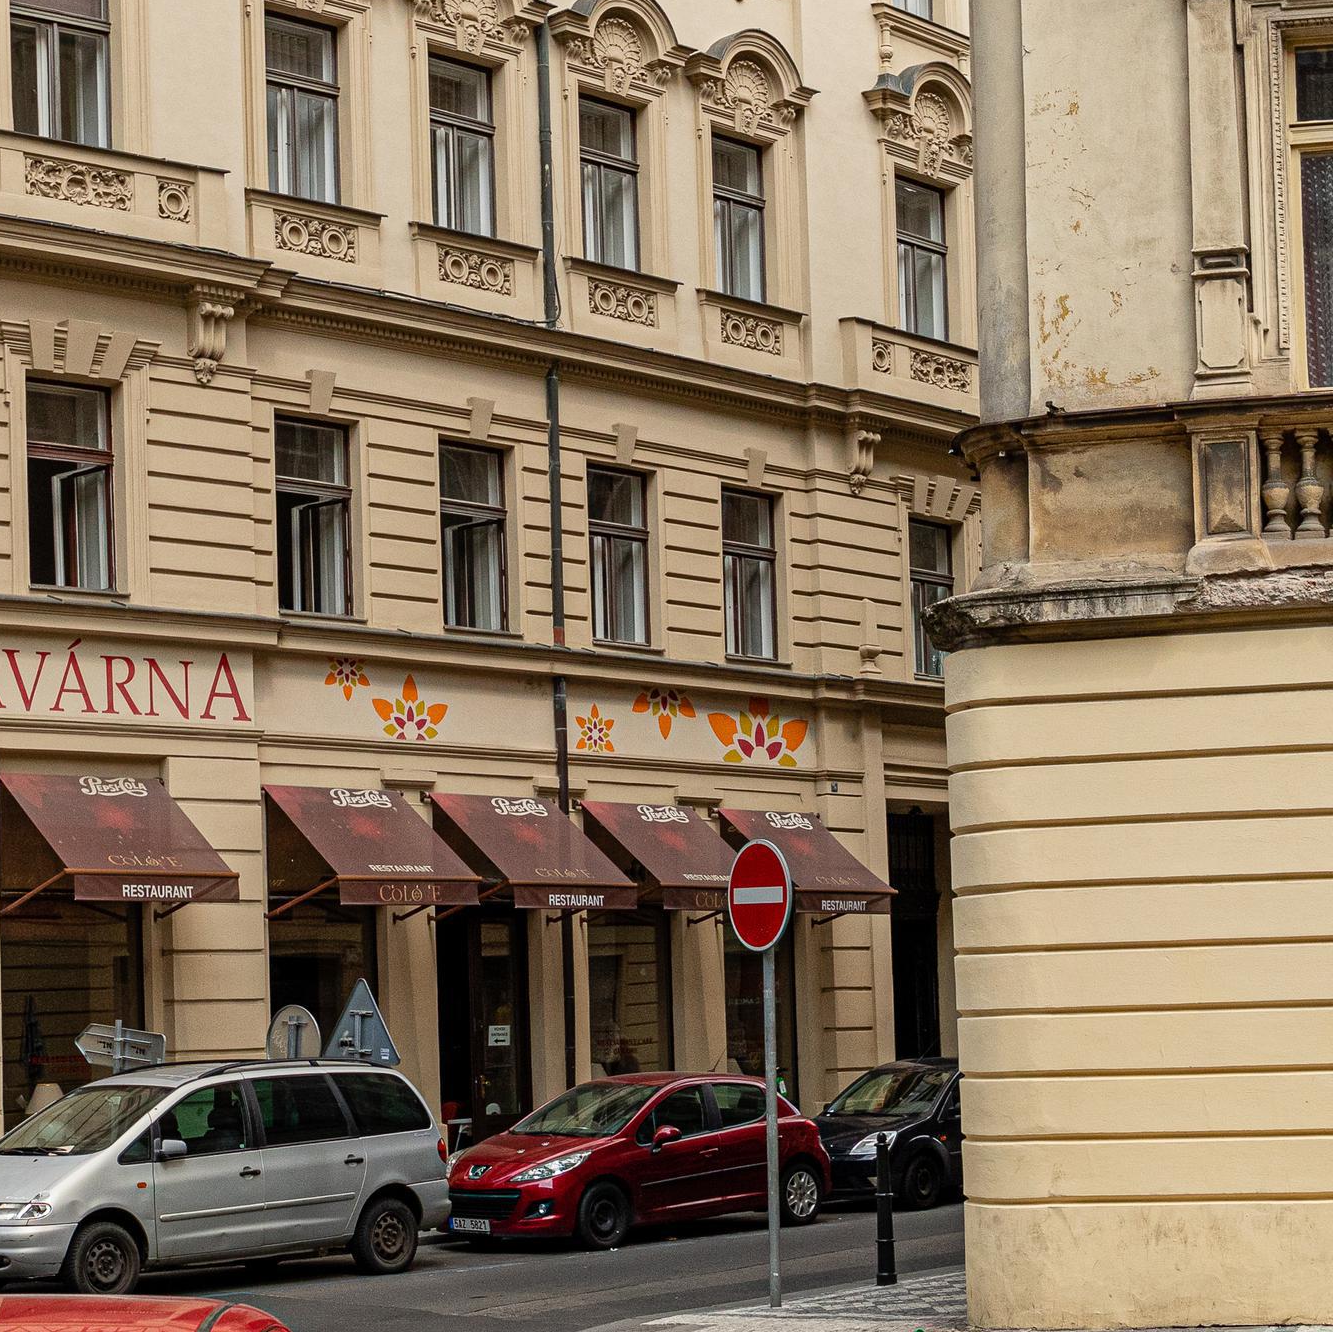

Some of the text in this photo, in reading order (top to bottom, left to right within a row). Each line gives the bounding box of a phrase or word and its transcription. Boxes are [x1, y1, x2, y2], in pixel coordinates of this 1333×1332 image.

[107, 854, 183, 867] COLOE
[368, 864, 434, 873] RESTAURANT
[122, 884, 194, 899] RESTAURANT
[379, 884, 443, 902] COLOE
[549, 894, 604, 907] RESTAURANT
[821, 900, 867, 912] RESTAURANT
[470, 1220, 487, 1230] 5821
